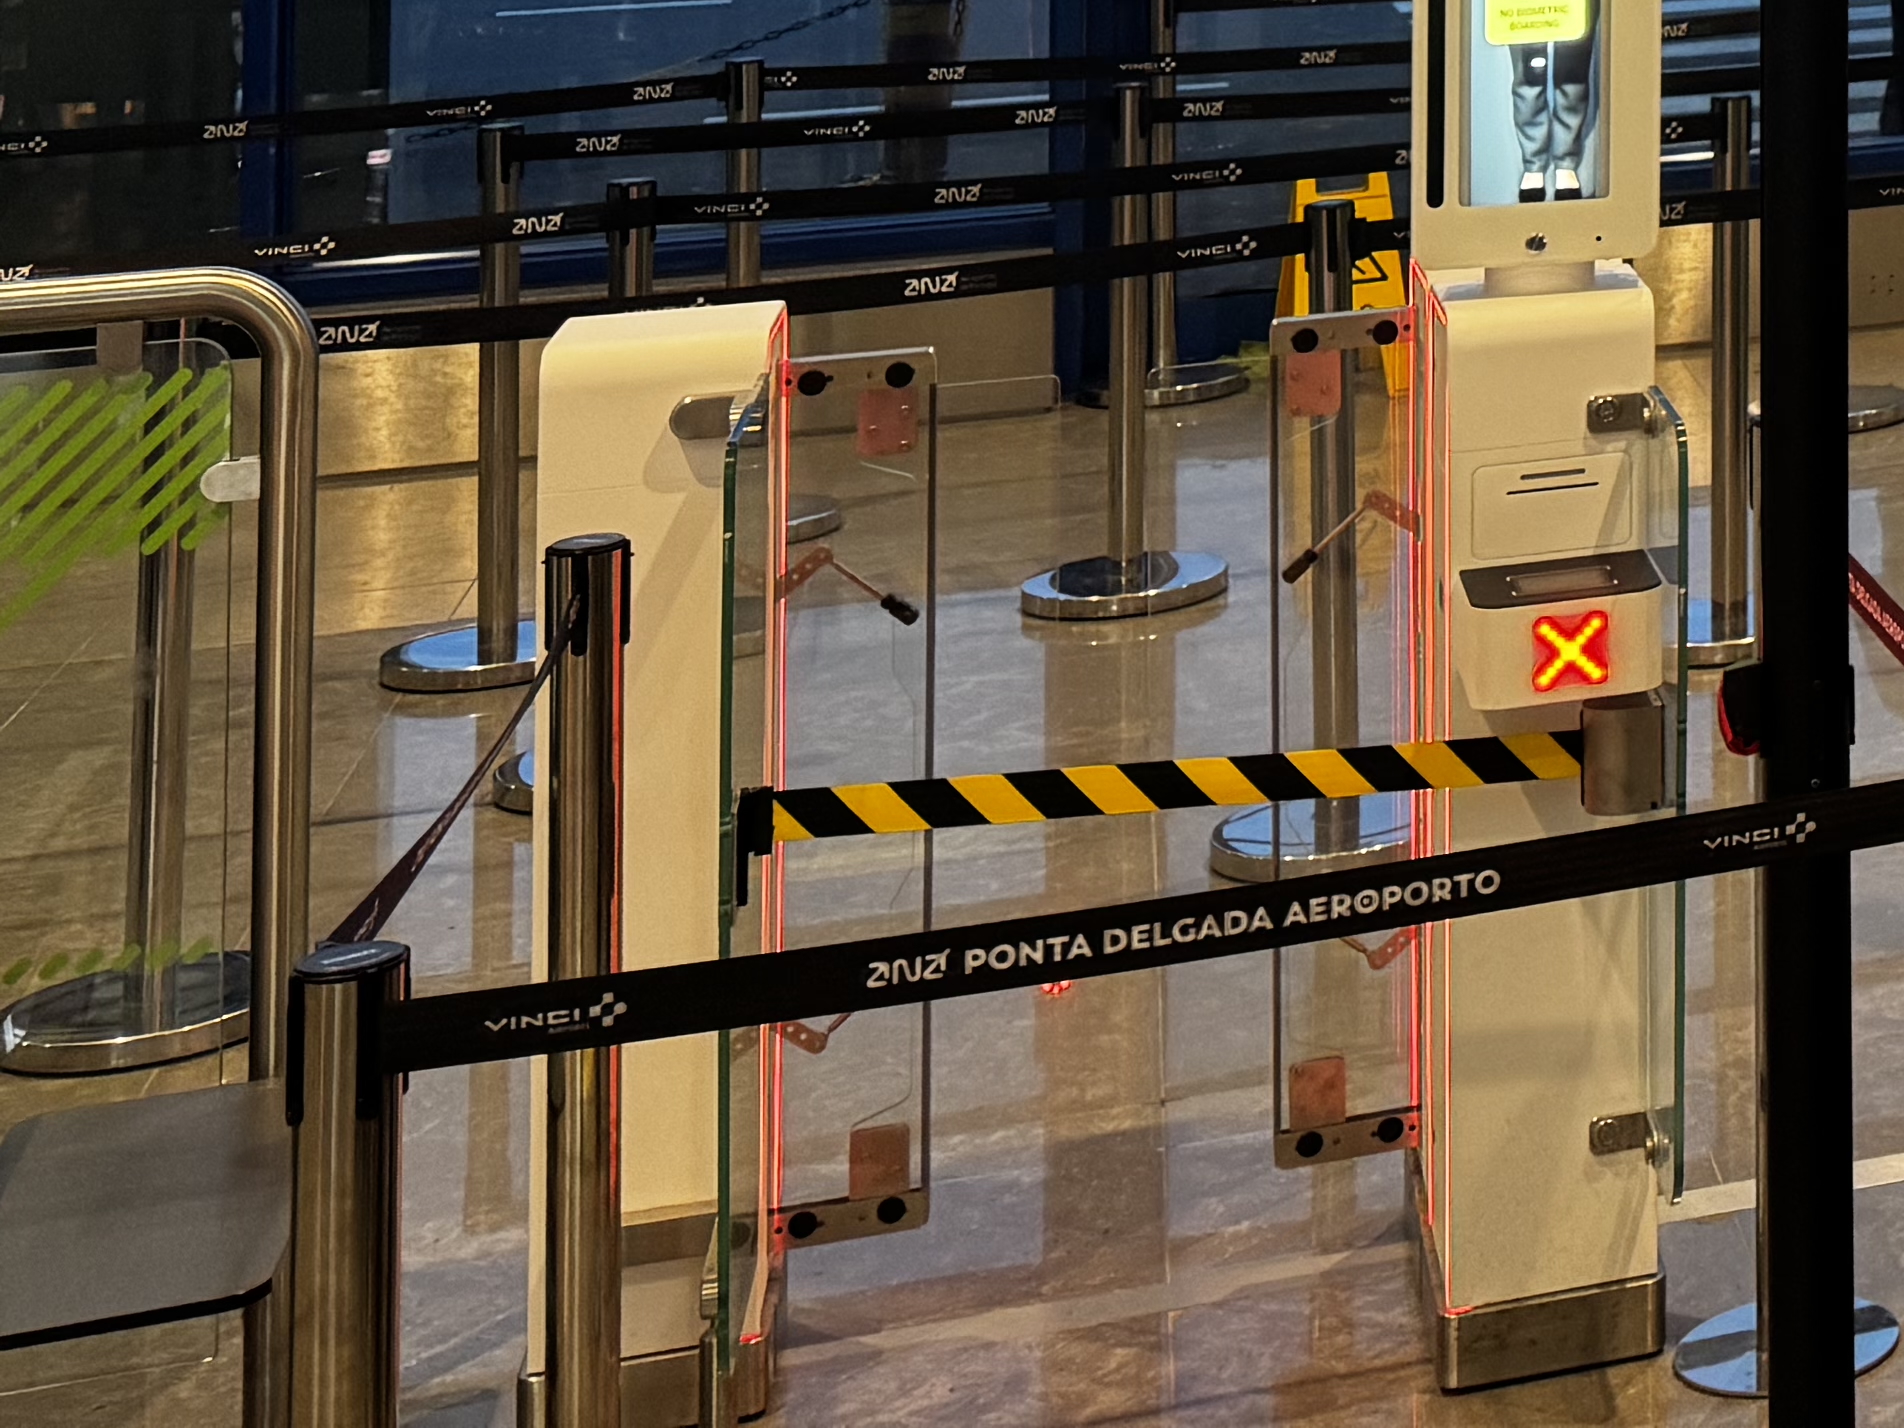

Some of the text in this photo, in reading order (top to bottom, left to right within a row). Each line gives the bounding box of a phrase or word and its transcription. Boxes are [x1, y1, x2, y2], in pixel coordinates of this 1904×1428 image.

[694, 203, 745, 215] VINCI
[254, 244, 310, 257] VINCI
[1177, 245, 1232, 259] VINCI
[1703, 827, 1779, 850] VINCI
[965, 933, 1093, 975] PONTA
[1102, 905, 1274, 956] DELGADA
[1283, 869, 1502, 928] AEROPORTO
[484, 1007, 580, 1032] VINCI
